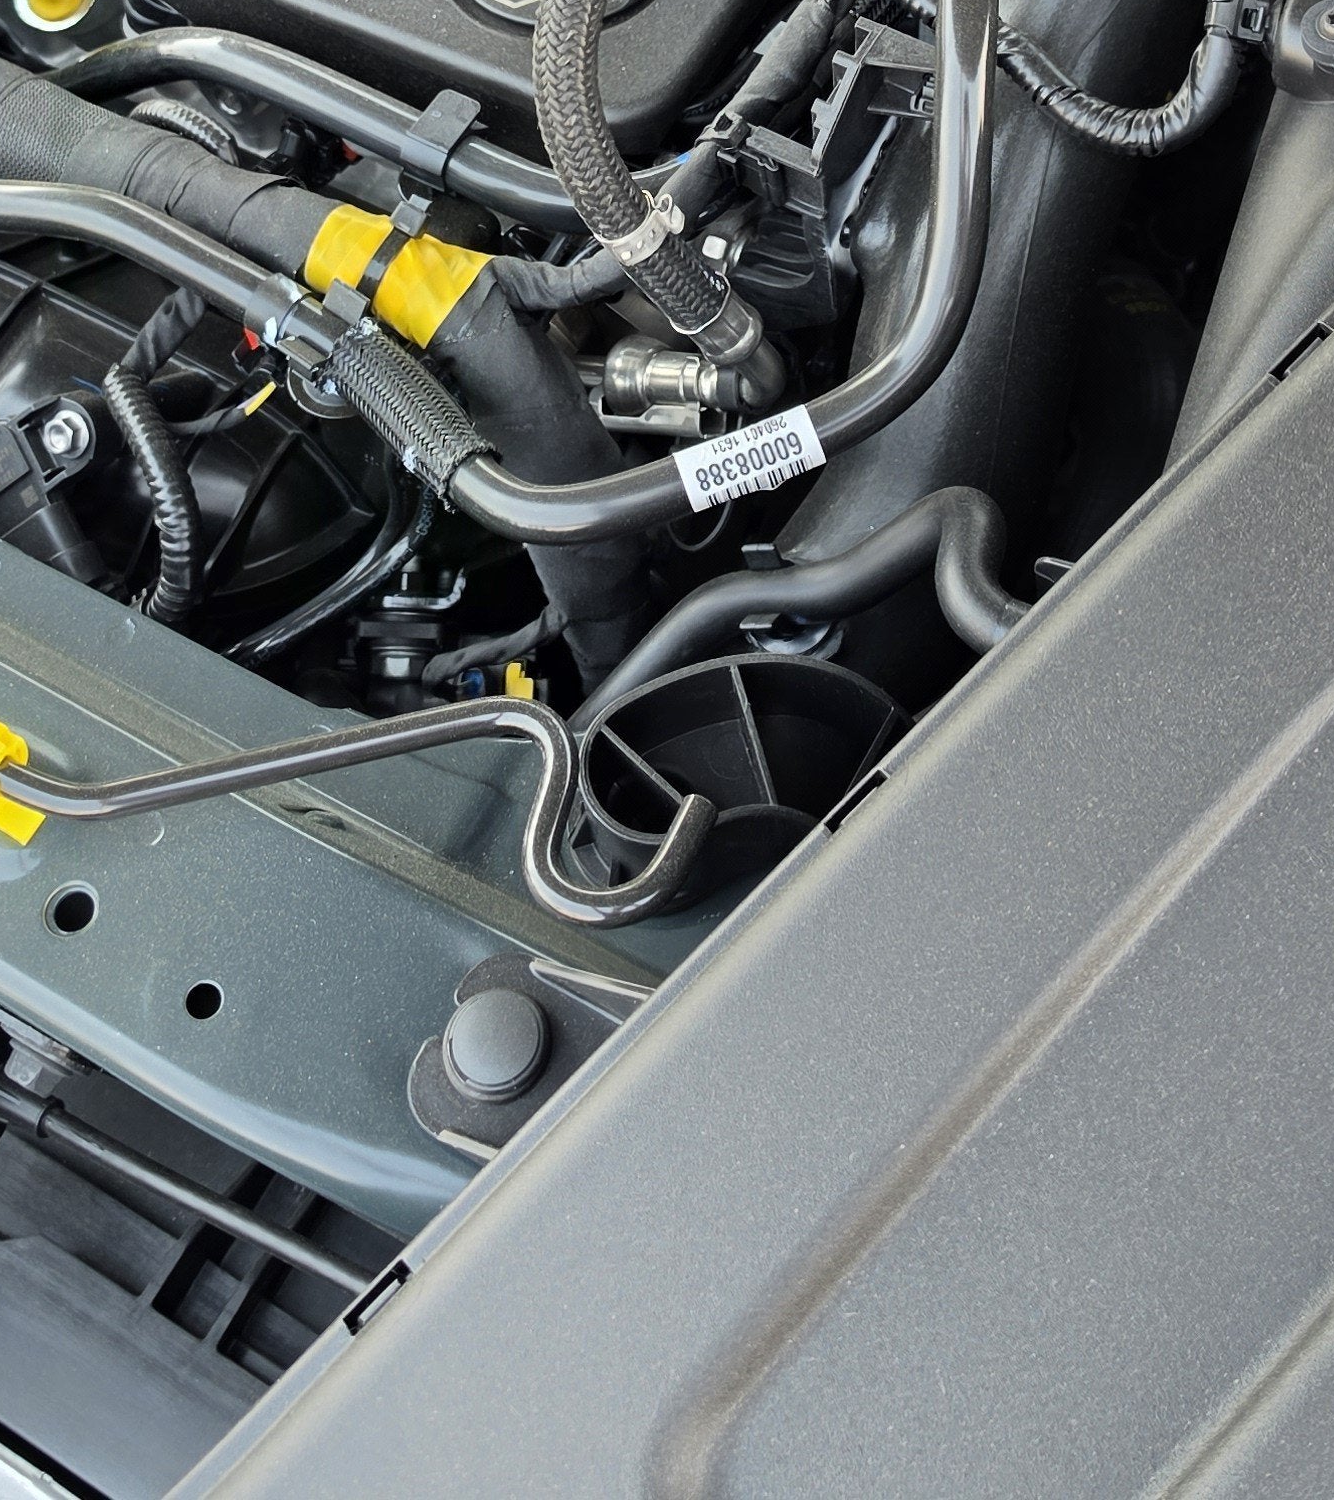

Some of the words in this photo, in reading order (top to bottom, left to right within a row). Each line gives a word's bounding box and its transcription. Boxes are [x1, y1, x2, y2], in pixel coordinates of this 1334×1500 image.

[743, 415, 787, 443] 260401
[711, 432, 741, 455] 1631
[695, 431, 804, 491] 60008388
